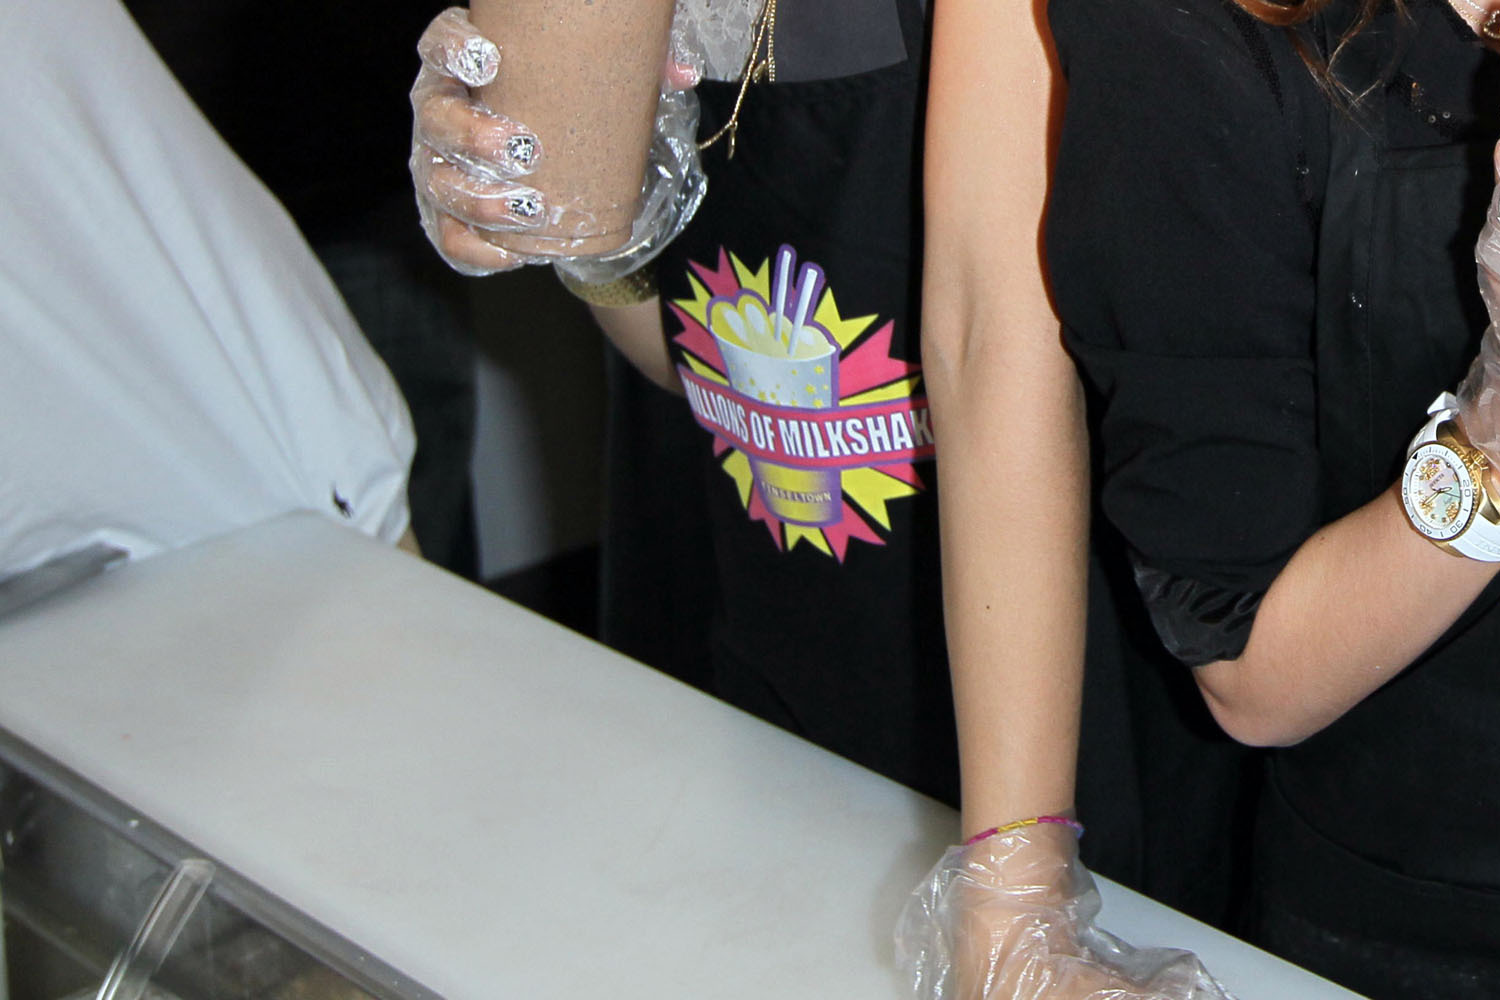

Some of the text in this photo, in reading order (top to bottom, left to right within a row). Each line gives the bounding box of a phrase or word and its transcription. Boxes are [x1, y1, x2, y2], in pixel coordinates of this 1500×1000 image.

[681, 373, 935, 458] MILLIONS OF MILKSHAK
[760, 480, 832, 504] TINSELTOWN
